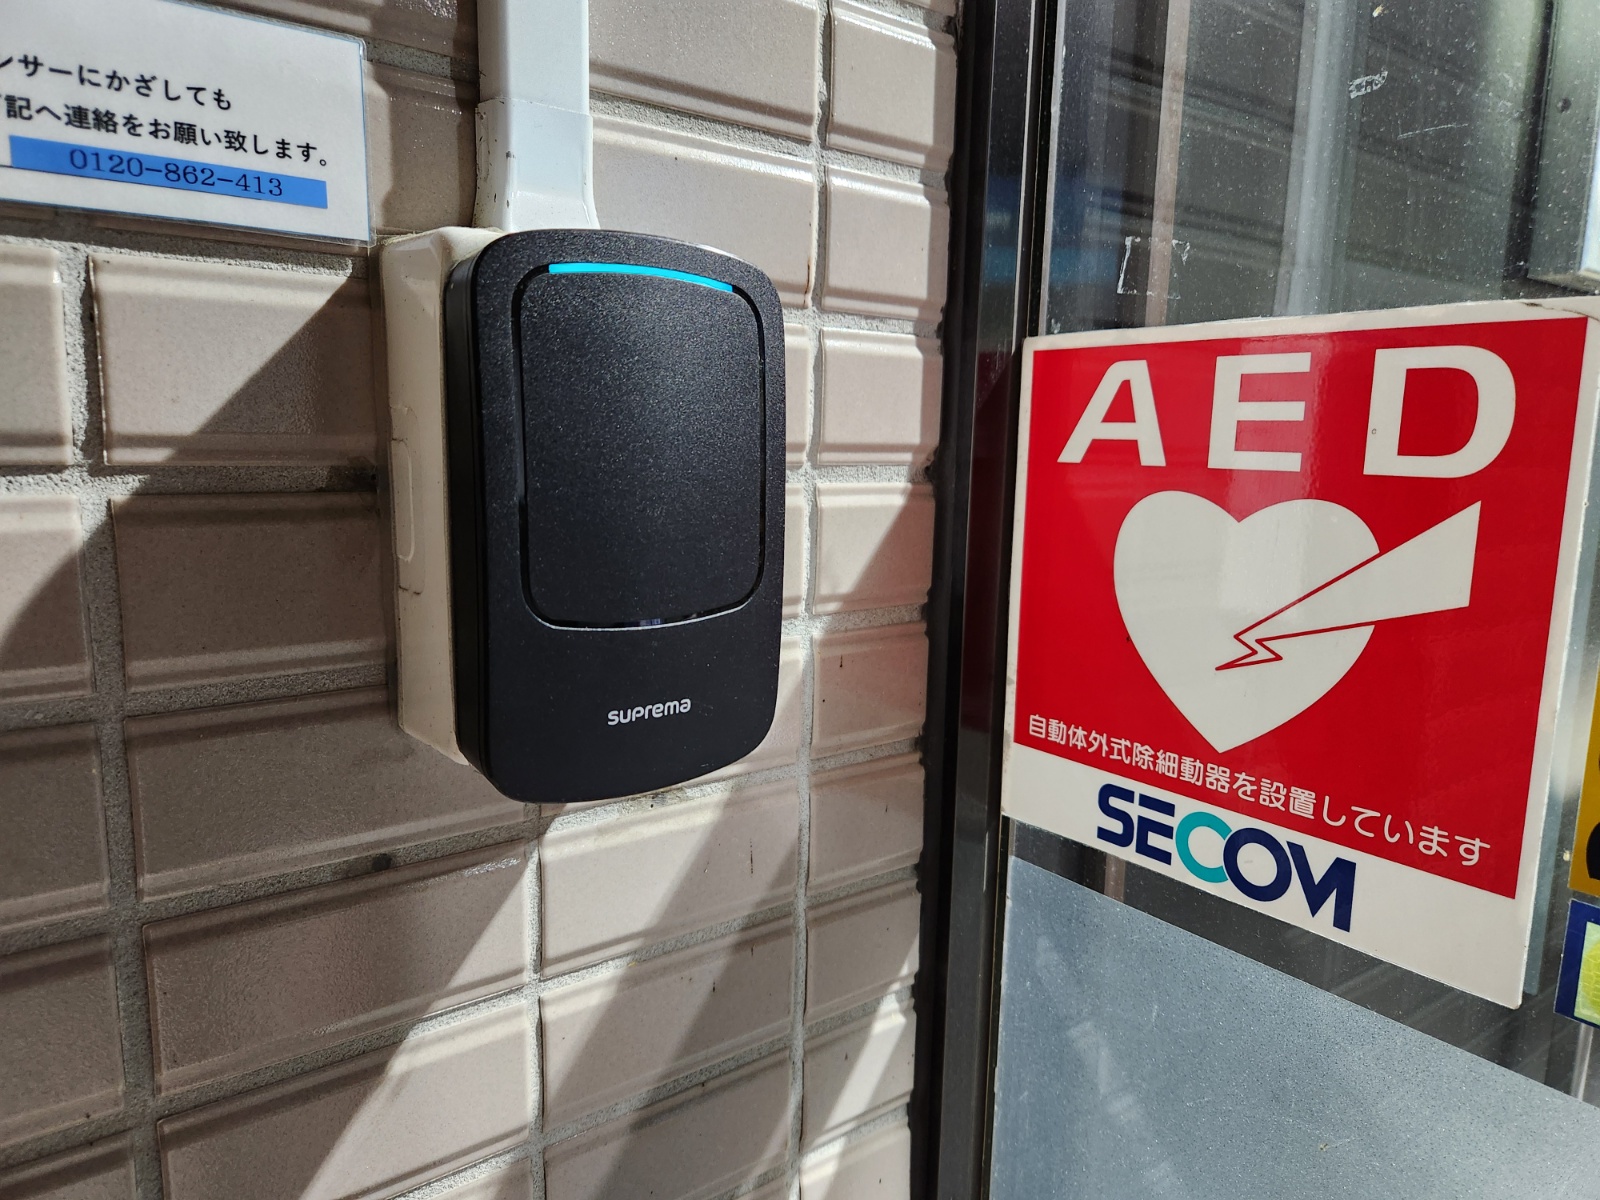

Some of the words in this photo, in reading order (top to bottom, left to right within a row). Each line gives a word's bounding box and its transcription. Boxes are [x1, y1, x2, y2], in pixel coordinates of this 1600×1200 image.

[0, 94, 328, 167] 記へ連絡をお願い致します。
[69, 148, 283, 197] 0120-862-413
[1057, 345, 1517, 479] AED
[607, 698, 692, 726] suprema
[1028, 714, 1491, 867] 自動体外式除細動器を設置しています
[1097, 783, 1357, 933] SECOM
